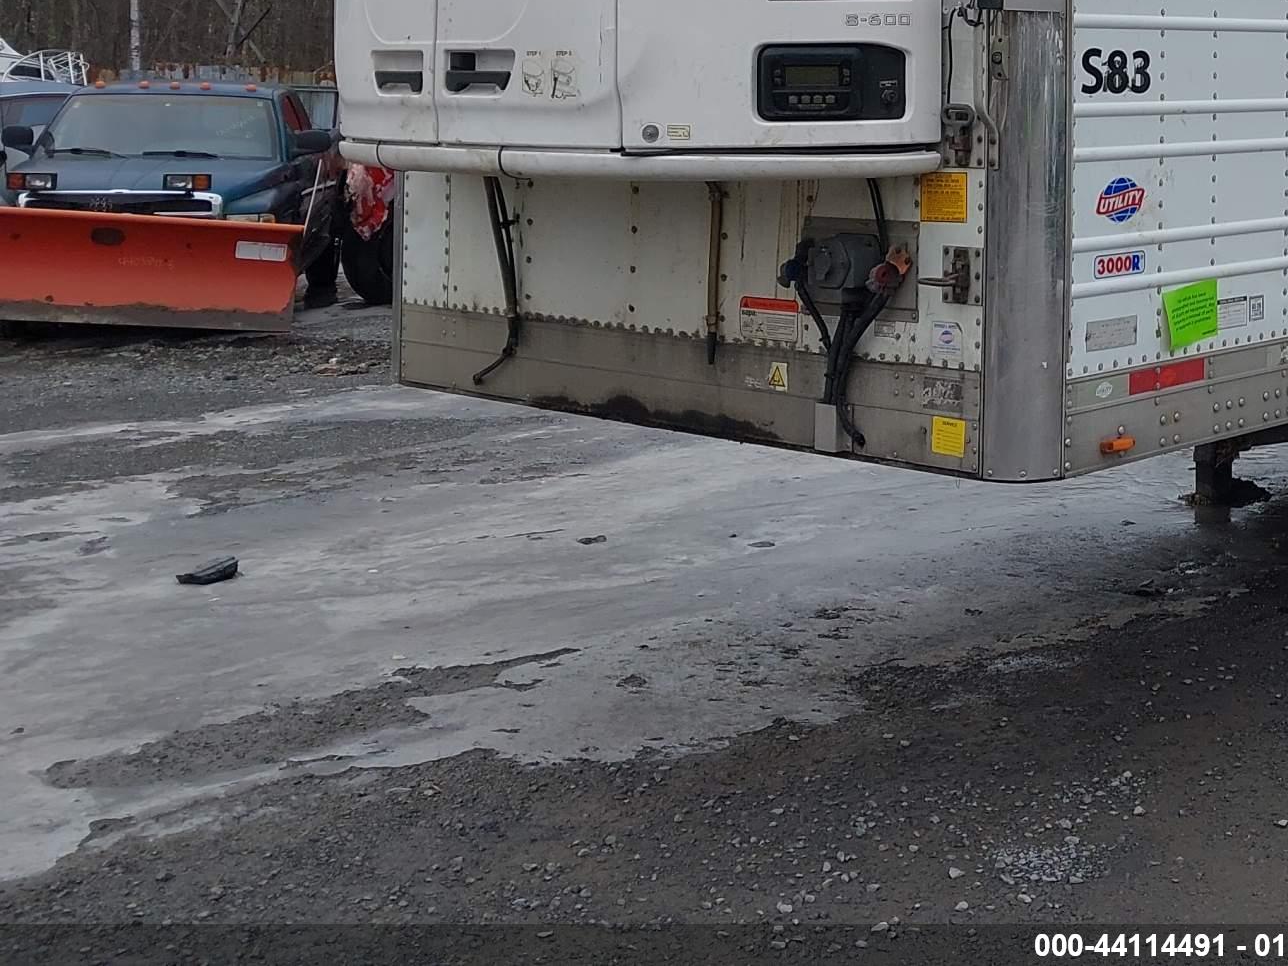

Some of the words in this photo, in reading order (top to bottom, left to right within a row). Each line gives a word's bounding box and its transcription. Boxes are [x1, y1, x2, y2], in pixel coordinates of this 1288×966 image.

[845, 13, 911, 26] S-600
[1081, 47, 1151, 95] S83
[1099, 190, 1143, 213] UTILITY
[1097, 254, 1141, 275] 3000R
